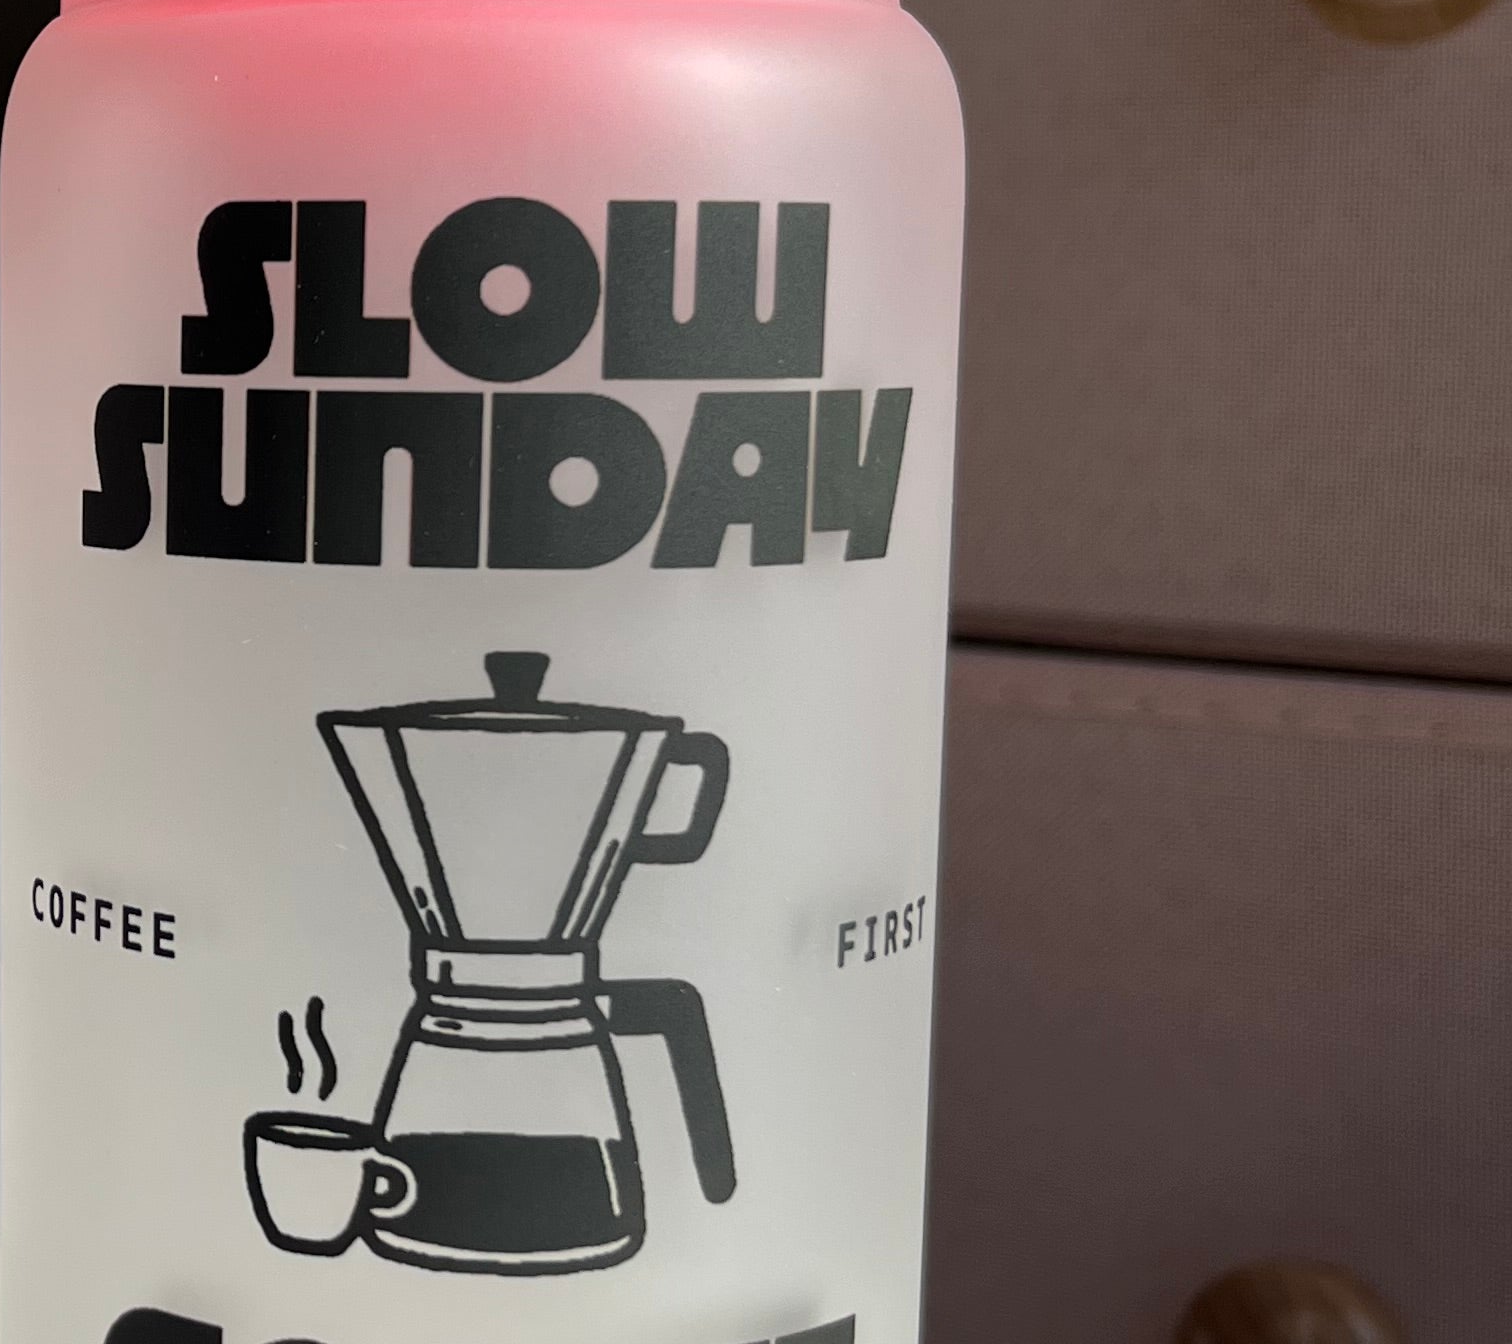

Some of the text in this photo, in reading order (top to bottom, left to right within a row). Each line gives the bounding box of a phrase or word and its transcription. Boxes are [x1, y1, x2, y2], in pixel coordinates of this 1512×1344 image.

[181, 196, 831, 383] SLOW
[82, 384, 913, 570] SUNDAY
[31, 878, 178, 959] COFFEE
[837, 895, 926, 968] FIRST
